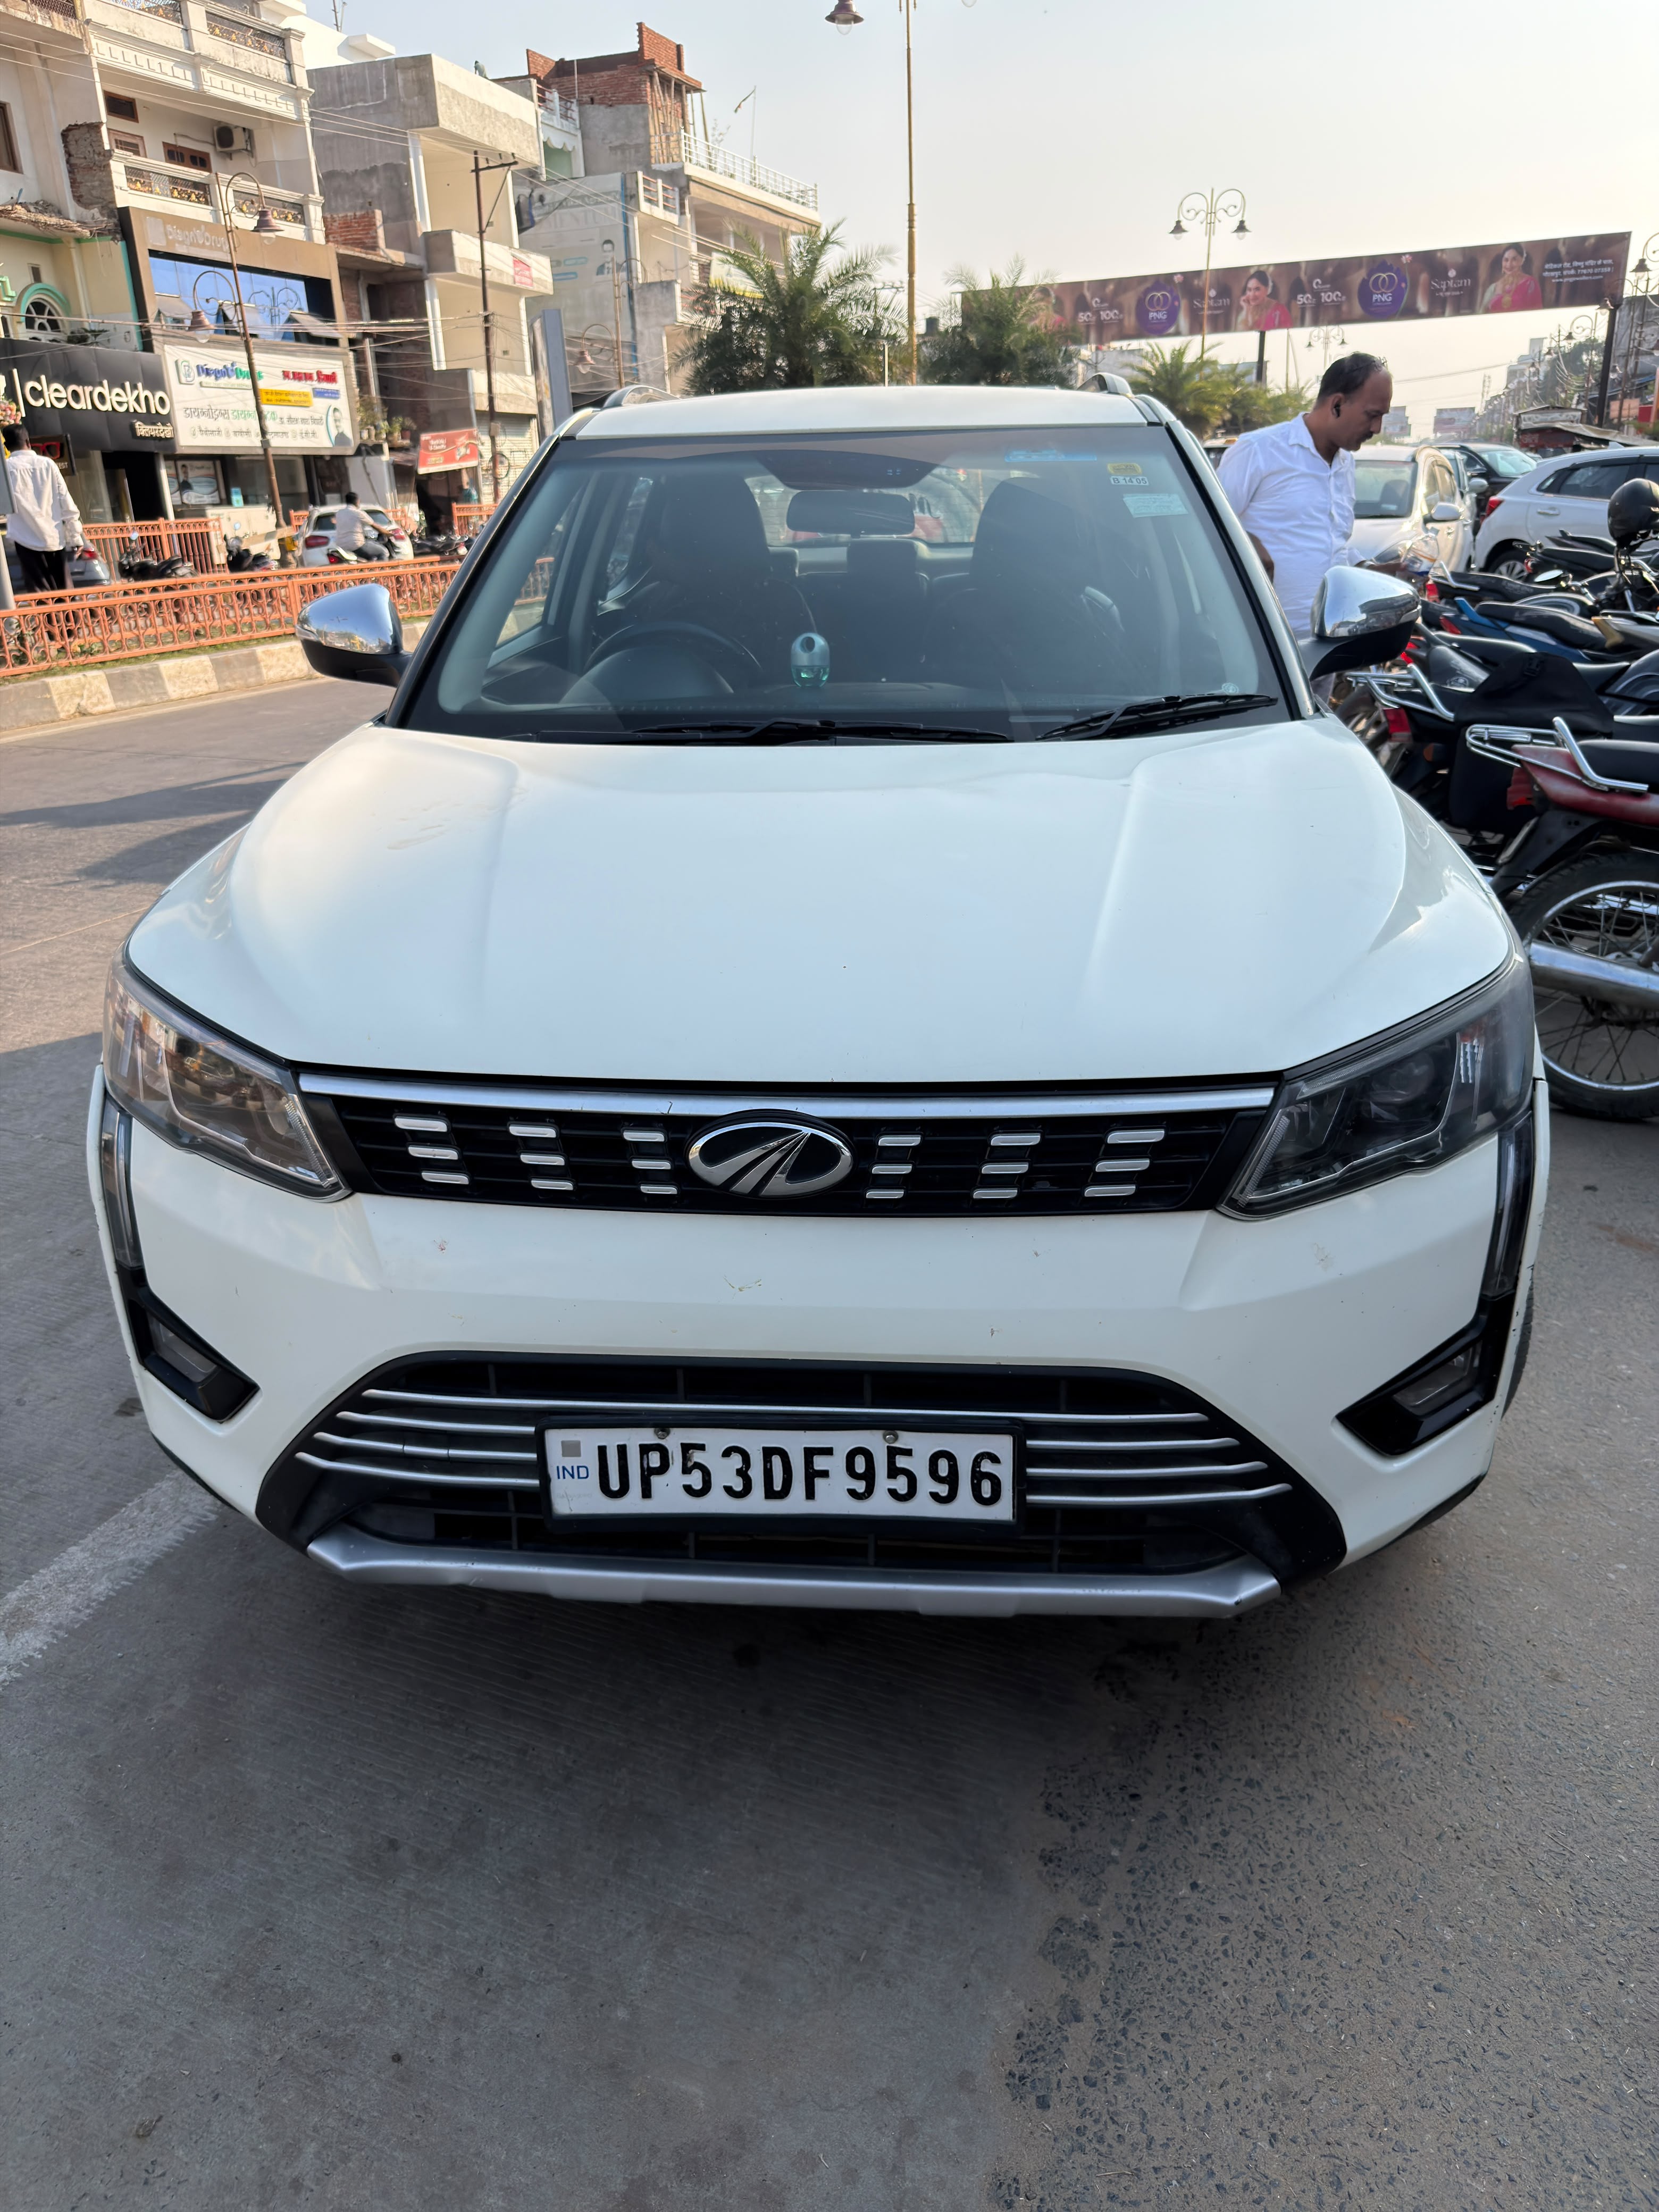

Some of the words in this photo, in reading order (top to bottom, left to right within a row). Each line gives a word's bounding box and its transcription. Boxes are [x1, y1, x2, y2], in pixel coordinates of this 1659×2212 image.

[1372, 293, 1393, 303] PNG
[1149, 311, 1168, 320] PNG
[25, 374, 171, 415] cleardekho
[556, 1465, 589, 1479] IND
[597, 1443, 1002, 1506] UP53DF9596
